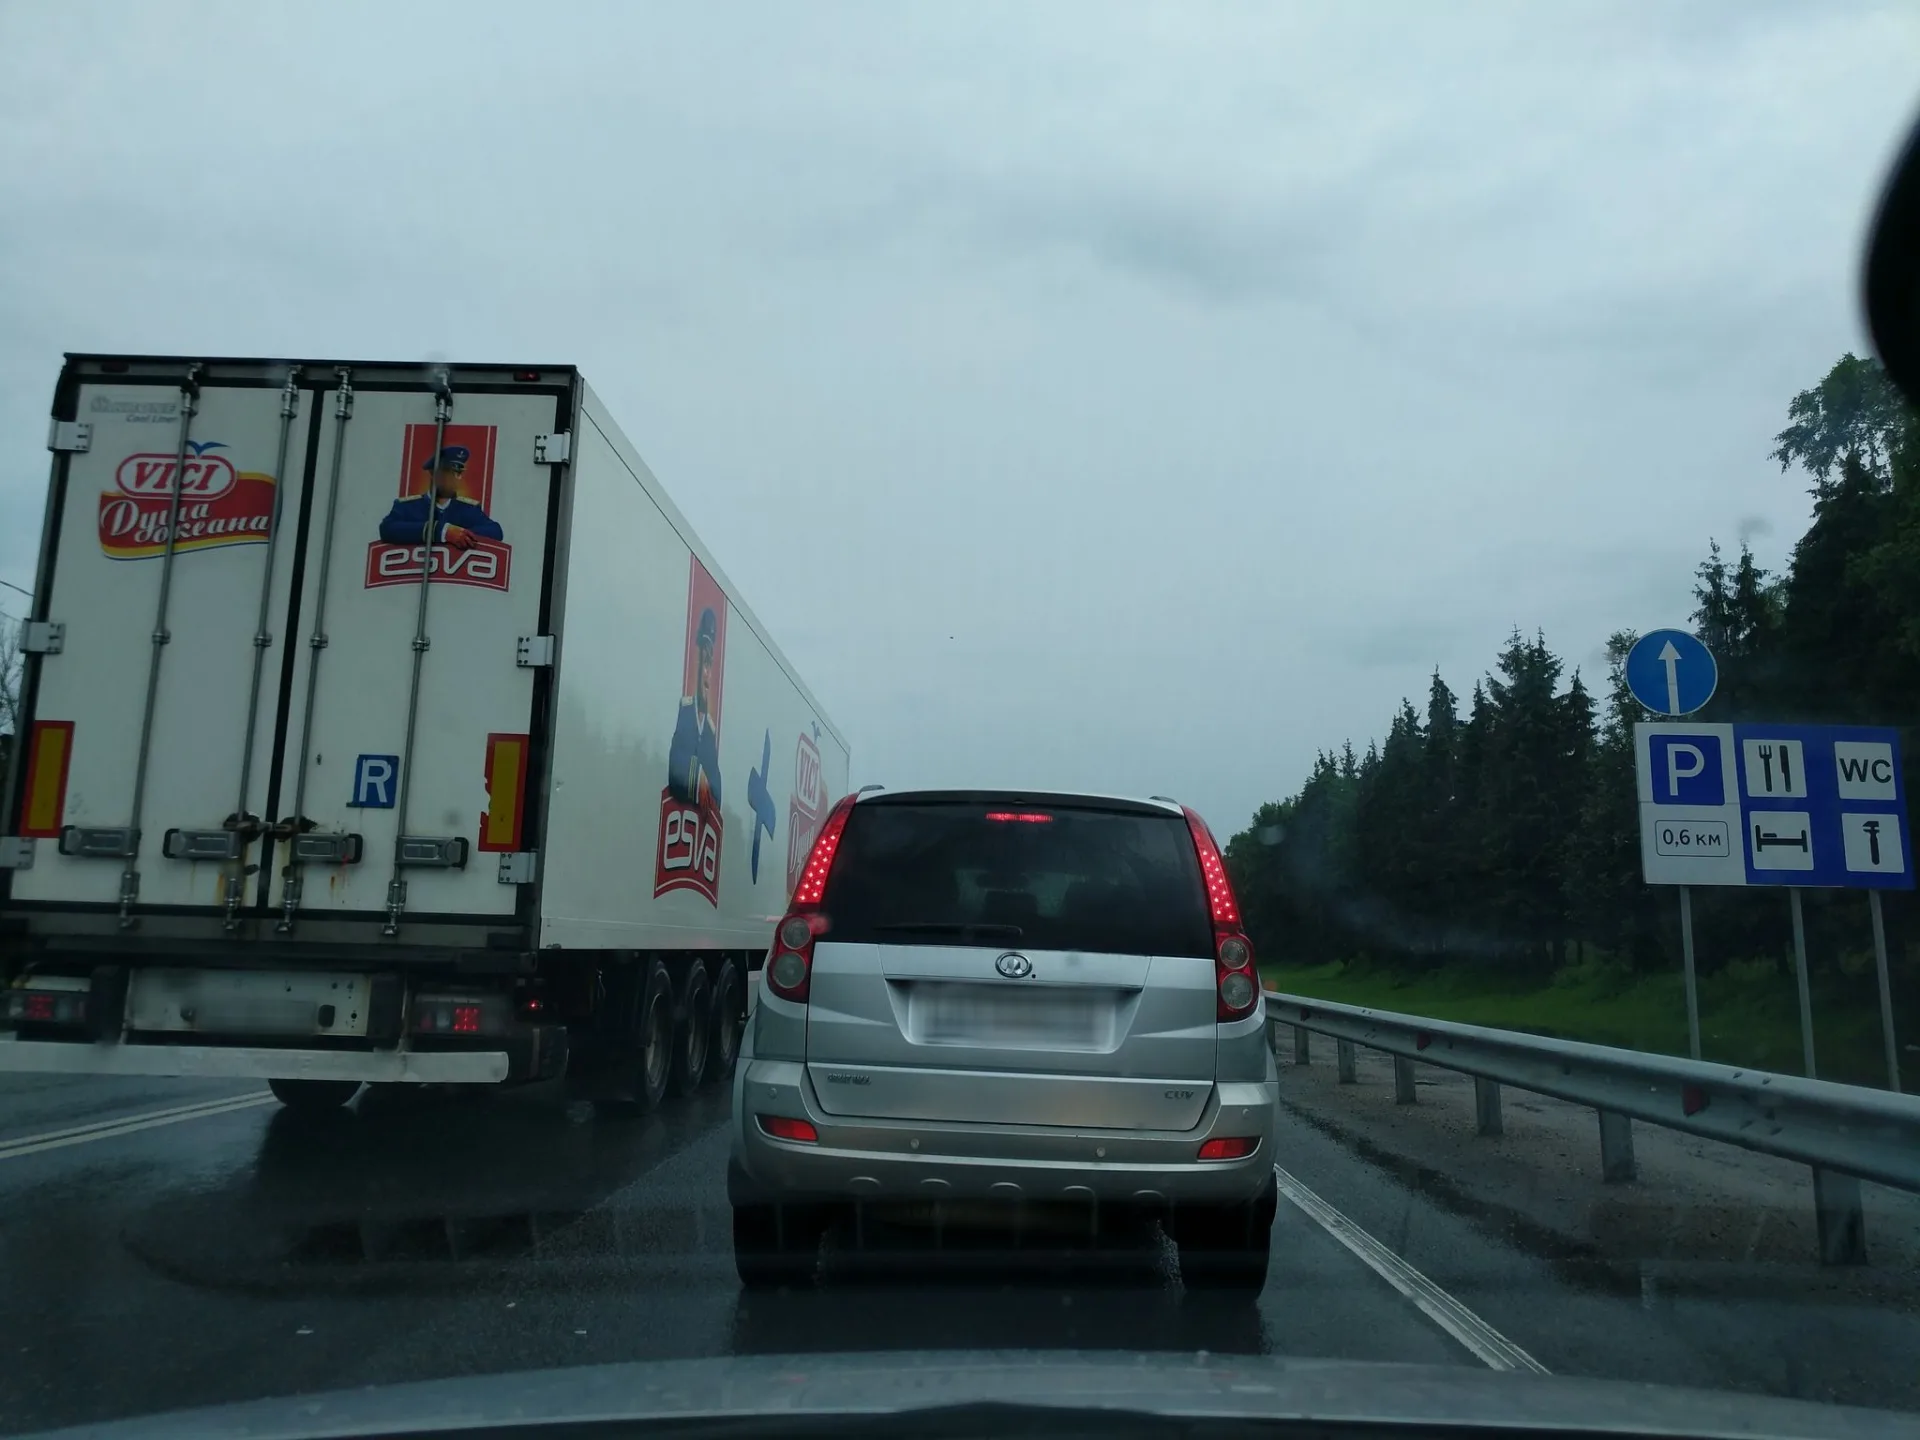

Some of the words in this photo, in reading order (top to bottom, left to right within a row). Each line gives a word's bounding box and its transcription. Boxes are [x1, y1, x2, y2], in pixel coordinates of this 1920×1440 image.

[133, 461, 220, 492] VICI
[379, 546, 499, 579] esva
[359, 759, 392, 803] R
[1667, 743, 1705, 796] P
[1839, 758, 1892, 784] WC
[663, 809, 718, 883] esva
[1662, 829, 1691, 848] 0,6
